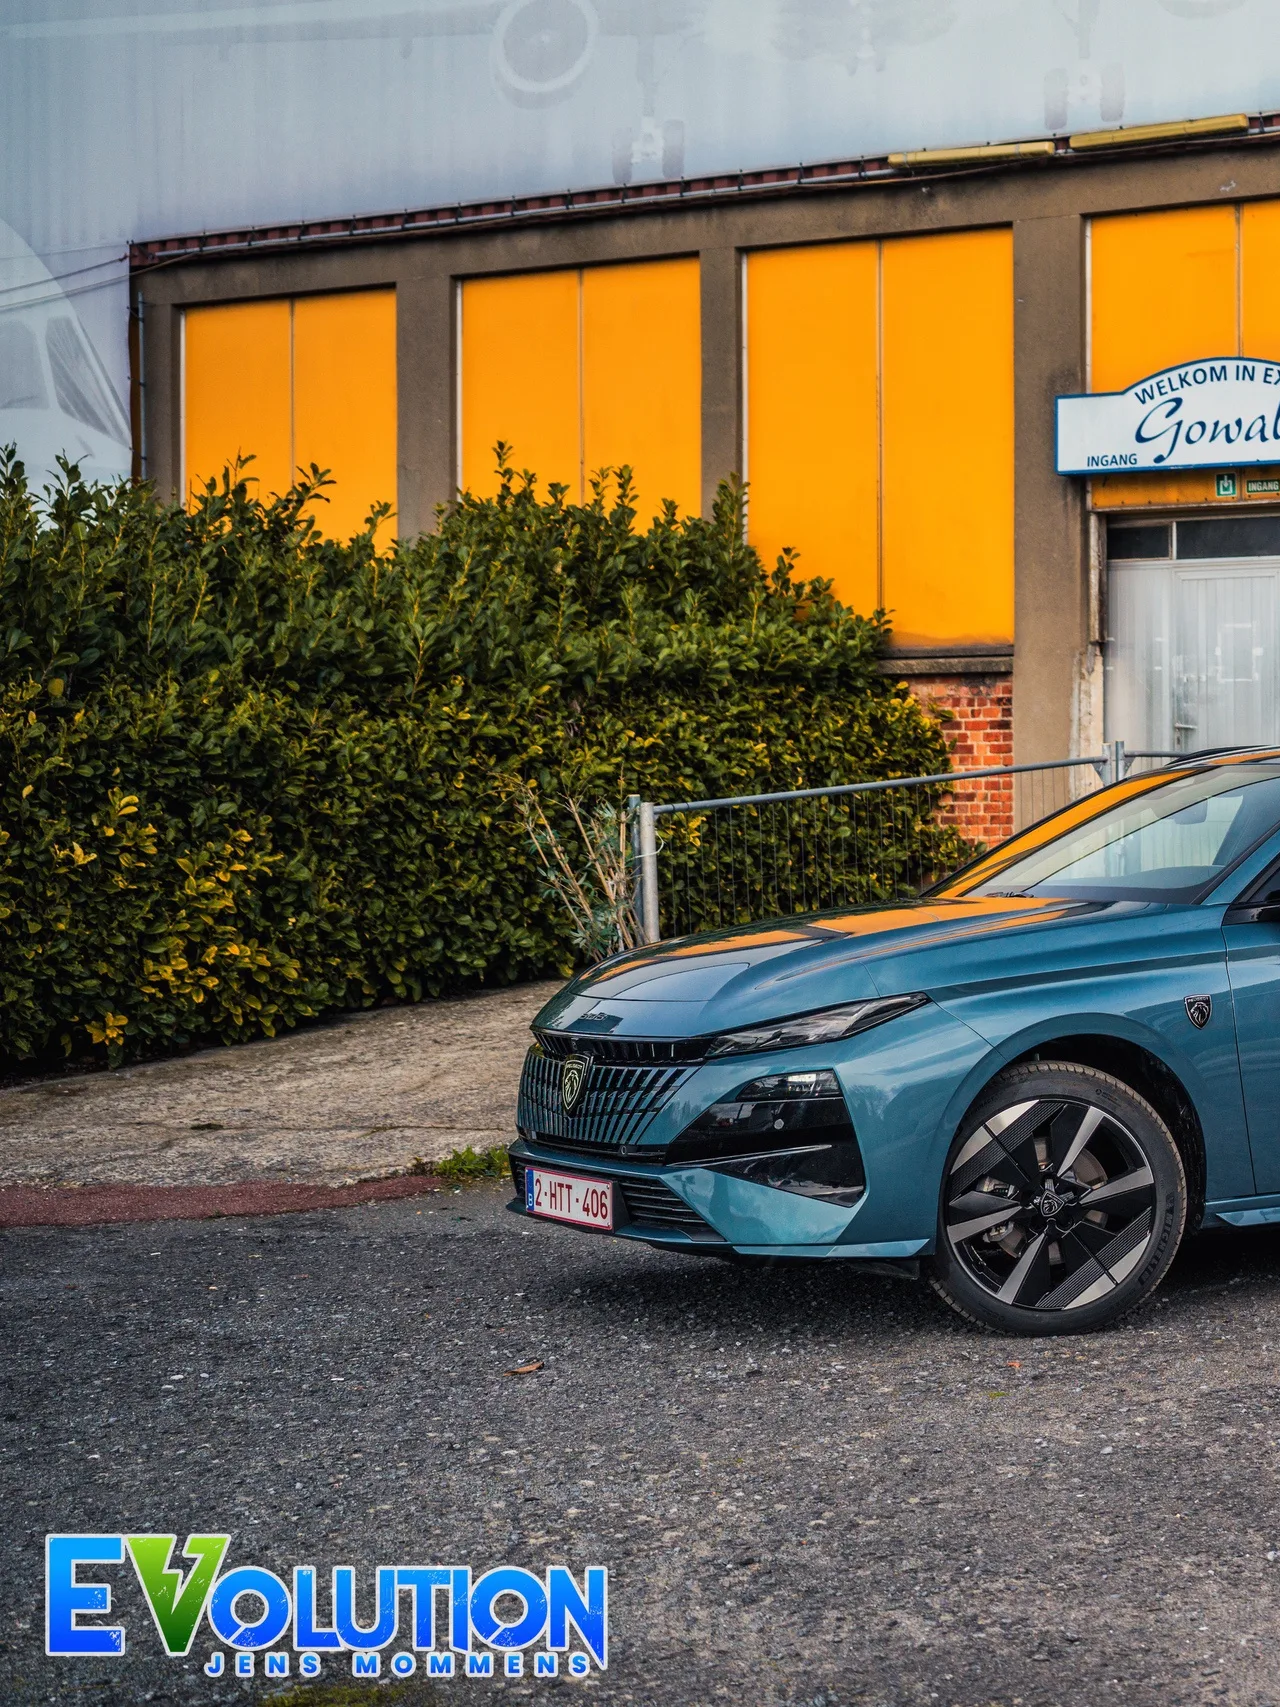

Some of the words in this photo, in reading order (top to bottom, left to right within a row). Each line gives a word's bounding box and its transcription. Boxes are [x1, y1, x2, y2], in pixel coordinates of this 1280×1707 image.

[1134, 365, 1228, 405] WELKOM
[1235, 365, 1255, 382] IN
[1087, 453, 1138, 468] INGANG
[1248, 481, 1279, 491] INGANG
[535, 1178, 608, 1220] 2-HTT-406
